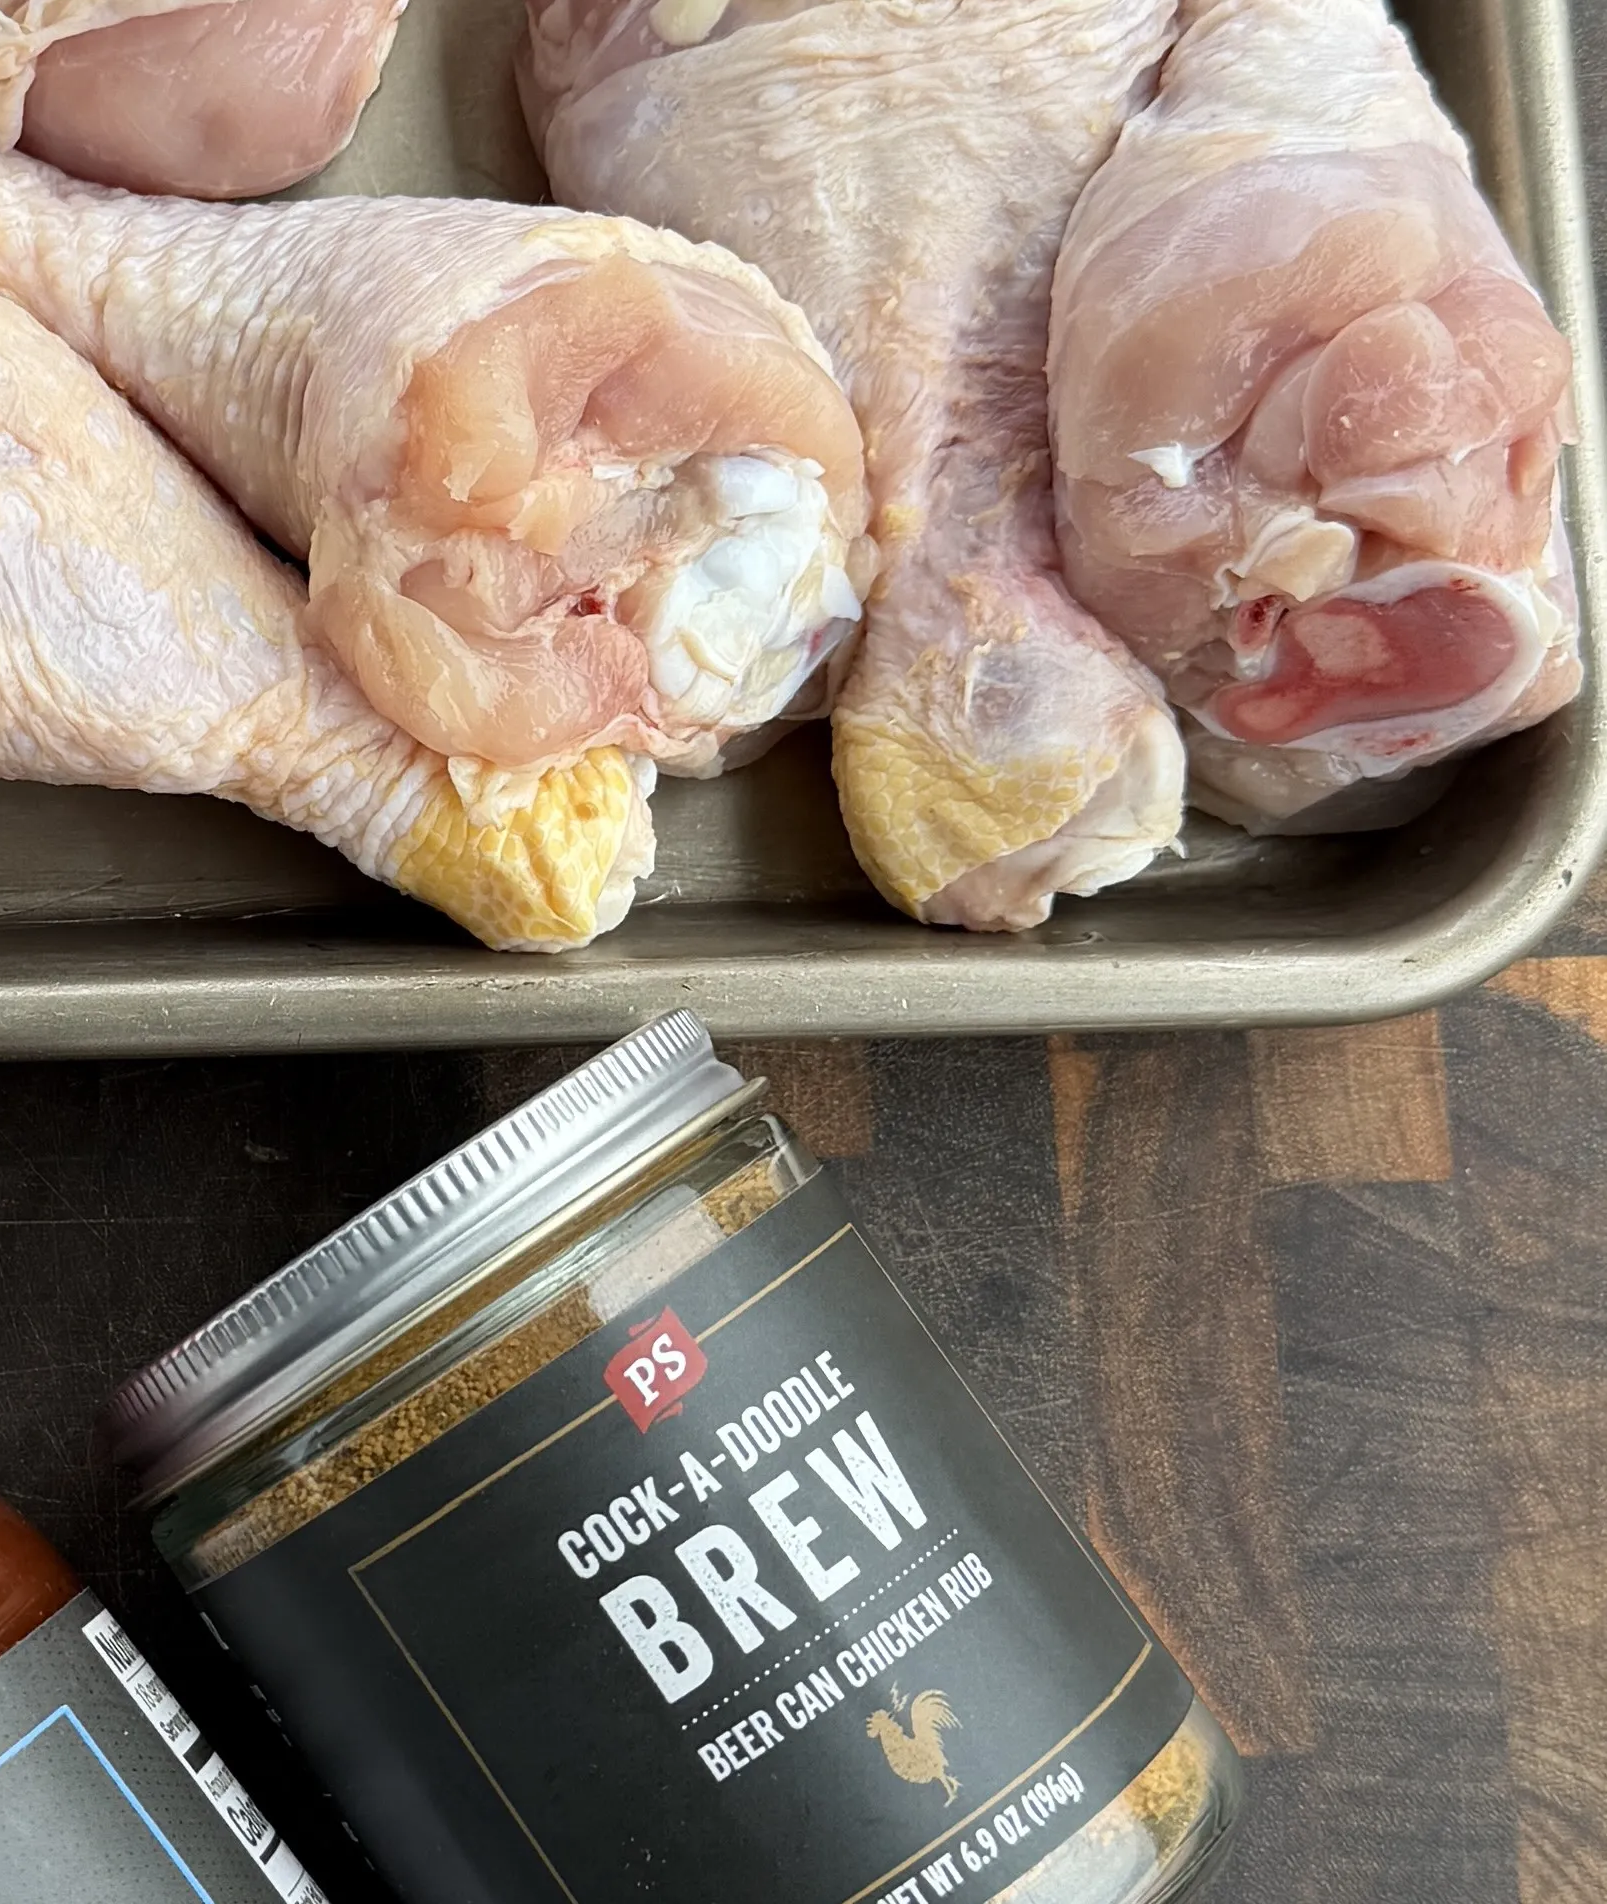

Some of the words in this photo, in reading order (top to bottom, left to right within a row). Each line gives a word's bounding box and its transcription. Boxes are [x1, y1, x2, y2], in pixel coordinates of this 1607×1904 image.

[557, 1350, 855, 1579] COCK-A-DOODLE
[623, 1333, 687, 1406] PS
[599, 1410, 927, 1704] BREW
[697, 1709, 784, 1783] BEER
[775, 1666, 845, 1730] CAN
[836, 1587, 951, 1688] CHICKEN
[938, 1552, 993, 1611] RUB
[920, 1853, 965, 1897] WT
[960, 1829, 998, 1872] 6.9
[995, 1803, 1030, 1845] OZ
[1021, 1761, 1085, 1826] (196g)
